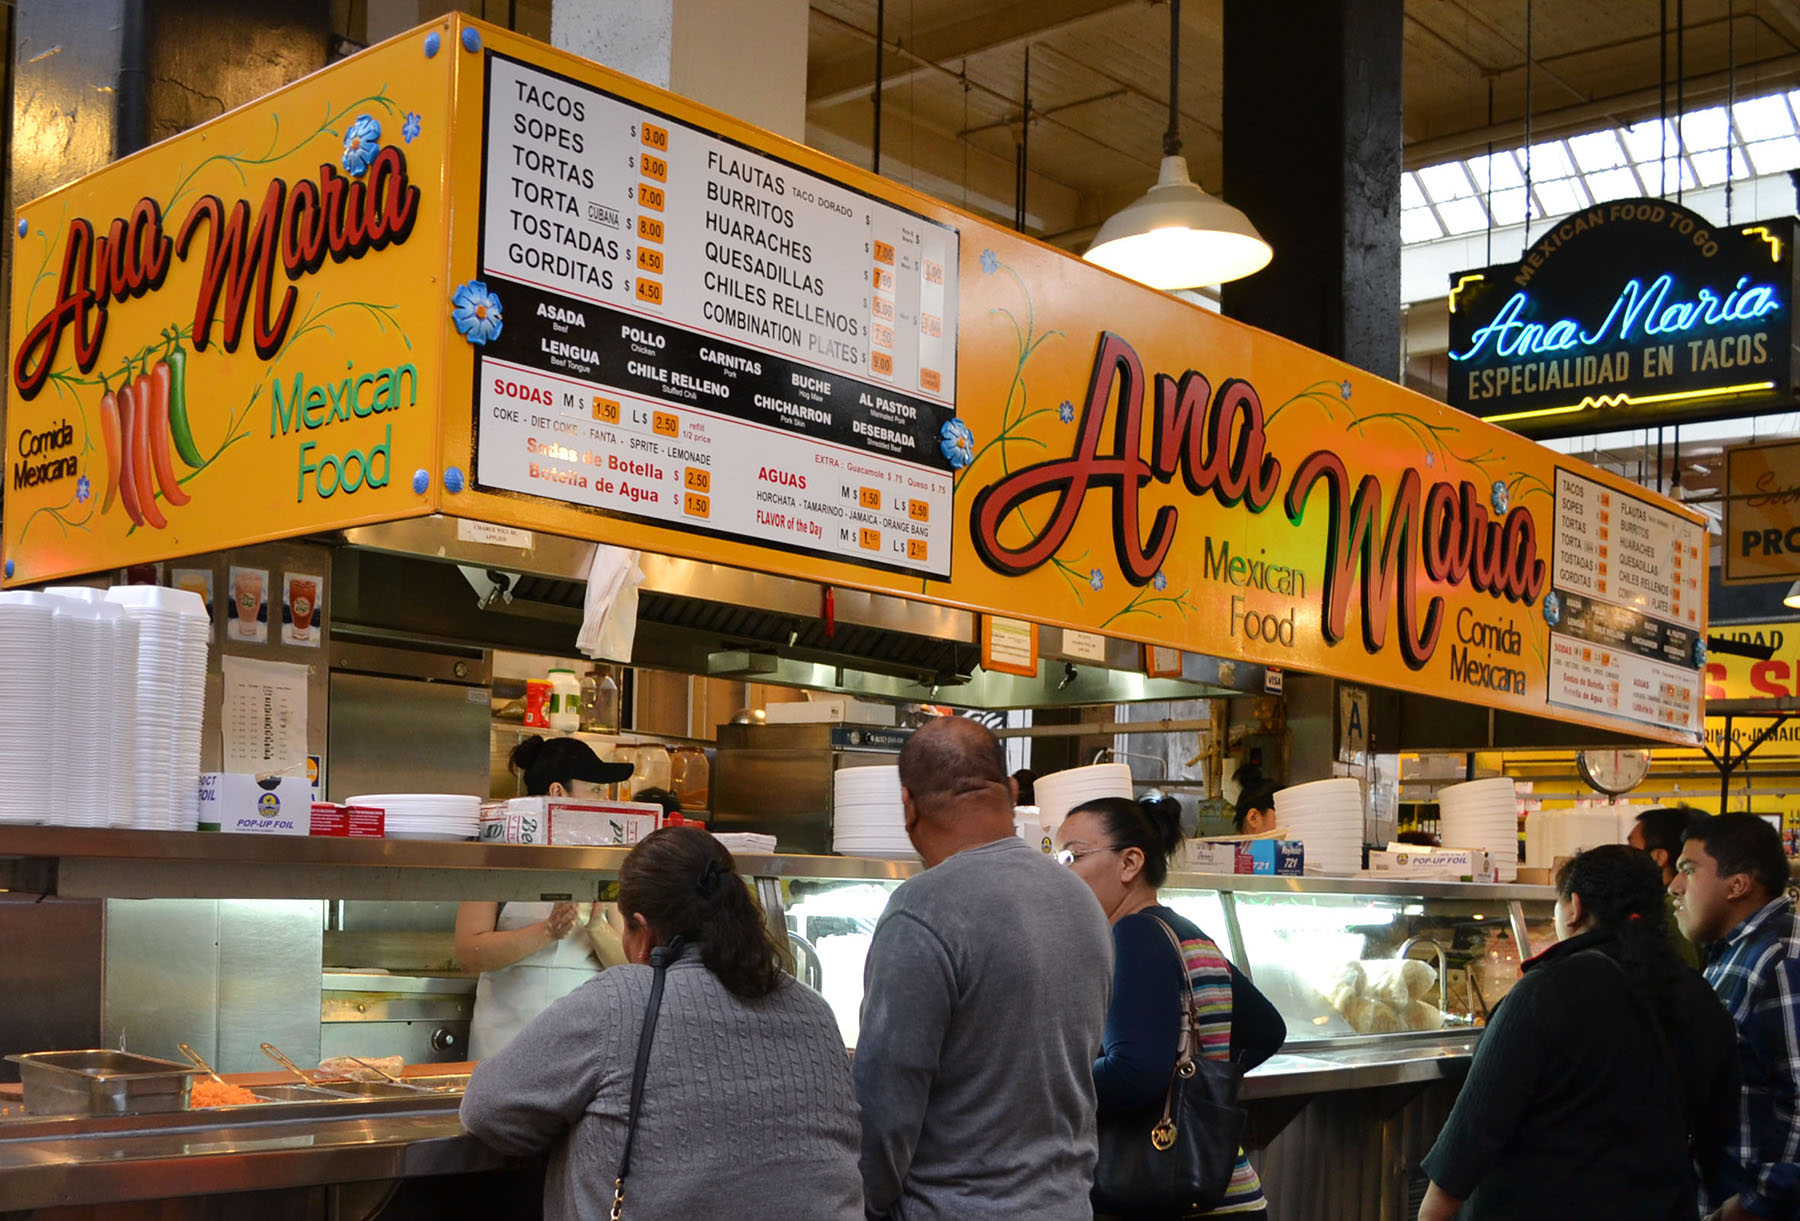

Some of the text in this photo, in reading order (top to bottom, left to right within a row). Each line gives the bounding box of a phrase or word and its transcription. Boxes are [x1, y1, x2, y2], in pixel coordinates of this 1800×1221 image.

[515, 80, 665, 147] TACOS 3.00
[514, 113, 664, 177] SOPES 3.00
[513, 144, 662, 207] TORTAS 7.00
[708, 151, 853, 218] FLAUTAS TACO DORADO
[511, 177, 662, 238] TORTA CUBANA 8.00
[707, 181, 794, 229] BURRITOS
[510, 209, 661, 269] TOSTADAS 4.50
[706, 210, 812, 263] HUARACHES
[1514, 204, 1719, 287] MEXICAN FOOD TO GO
[508, 243, 660, 302] GORDITAS 4.50
[705, 241, 823, 297] QUESADILLAS
[14, 196, 173, 401] Ana
[536, 302, 586, 328] ASADA
[704, 271, 766, 307] CHILES
[774, 293, 858, 336] RELLENOS
[553, 322, 569, 334] Beef
[621, 325, 666, 349] POLLO
[703, 301, 890, 372] COMBINATION PLATES 9.00
[1449, 292, 1579, 360] Ana
[541, 338, 600, 366] LENGUA
[551, 356, 591, 374] Beef Tongue
[631, 344, 656, 357] Chicken
[700, 348, 762, 375] CARNITAS
[1469, 333, 1768, 401] ESPECIALIDAD EN TACOS
[628, 361, 730, 398] CHILE RELLENO
[723, 368, 737, 379] Pork
[792, 373, 831, 396] BUCHE
[270, 360, 417, 438] Mexican
[494, 379, 676, 432] SODAS M 1.50 L 2.50
[754, 394, 832, 426] CHICHARRON
[859, 392, 917, 420] AL PASTOR
[18, 418, 74, 458] Comida
[493, 407, 711, 466] COKE DIET COKE FANTA SPRITE LEMONADE
[683, 430, 711, 444] 1/2 price
[853, 420, 915, 449] DESEBRADA
[13, 454, 77, 491] Mexicana
[298, 423, 392, 503] Food
[527, 437, 708, 488] Sodas de Botella 2.50
[847, 463, 928, 490] Guacamole Queso
[970, 330, 1280, 588] Ana
[529, 463, 707, 513] Botella de Agua 1.50
[758, 466, 927, 518] AGUAS M 1.50 L 2.50
[1562, 480, 1584, 498] TACOS
[1562, 498, 1583, 516] SOPES
[756, 509, 785, 531] FLAVOR
[787, 516, 795, 530] of
[796, 517, 808, 533] the
[809, 520, 823, 539] Day
[840, 529, 849, 541] M
[893, 540, 899, 552] L
[757, 490, 929, 538] HORCHATA TAMARINDO JAMAICA ORANGE BANG
[1561, 515, 1586, 534] TORTAS
[1620, 520, 1649, 540] BURRITOS
[1621, 502, 1646, 521] FLAUTAS
[1561, 533, 1581, 548] TORTA
[1620, 536, 1655, 558] HUARACHES
[1204, 536, 1304, 598] Mexican
[1560, 568, 1591, 589] GORDITAS
[1561, 550, 1594, 571] TOSTADAS
[1619, 553, 1658, 576] QUESADILLAS
[1230, 594, 1295, 647] Food
[1456, 607, 1521, 656] Comida
[1451, 651, 1526, 696] Mexicana
[1348, 702, 1363, 739] A
[237, 819, 294, 829] POP-UP FOIL
[1253, 861, 1270, 871] 721
[1284, 858, 1298, 868] 721
[1413, 856, 1467, 865] POP-UP FOIL
